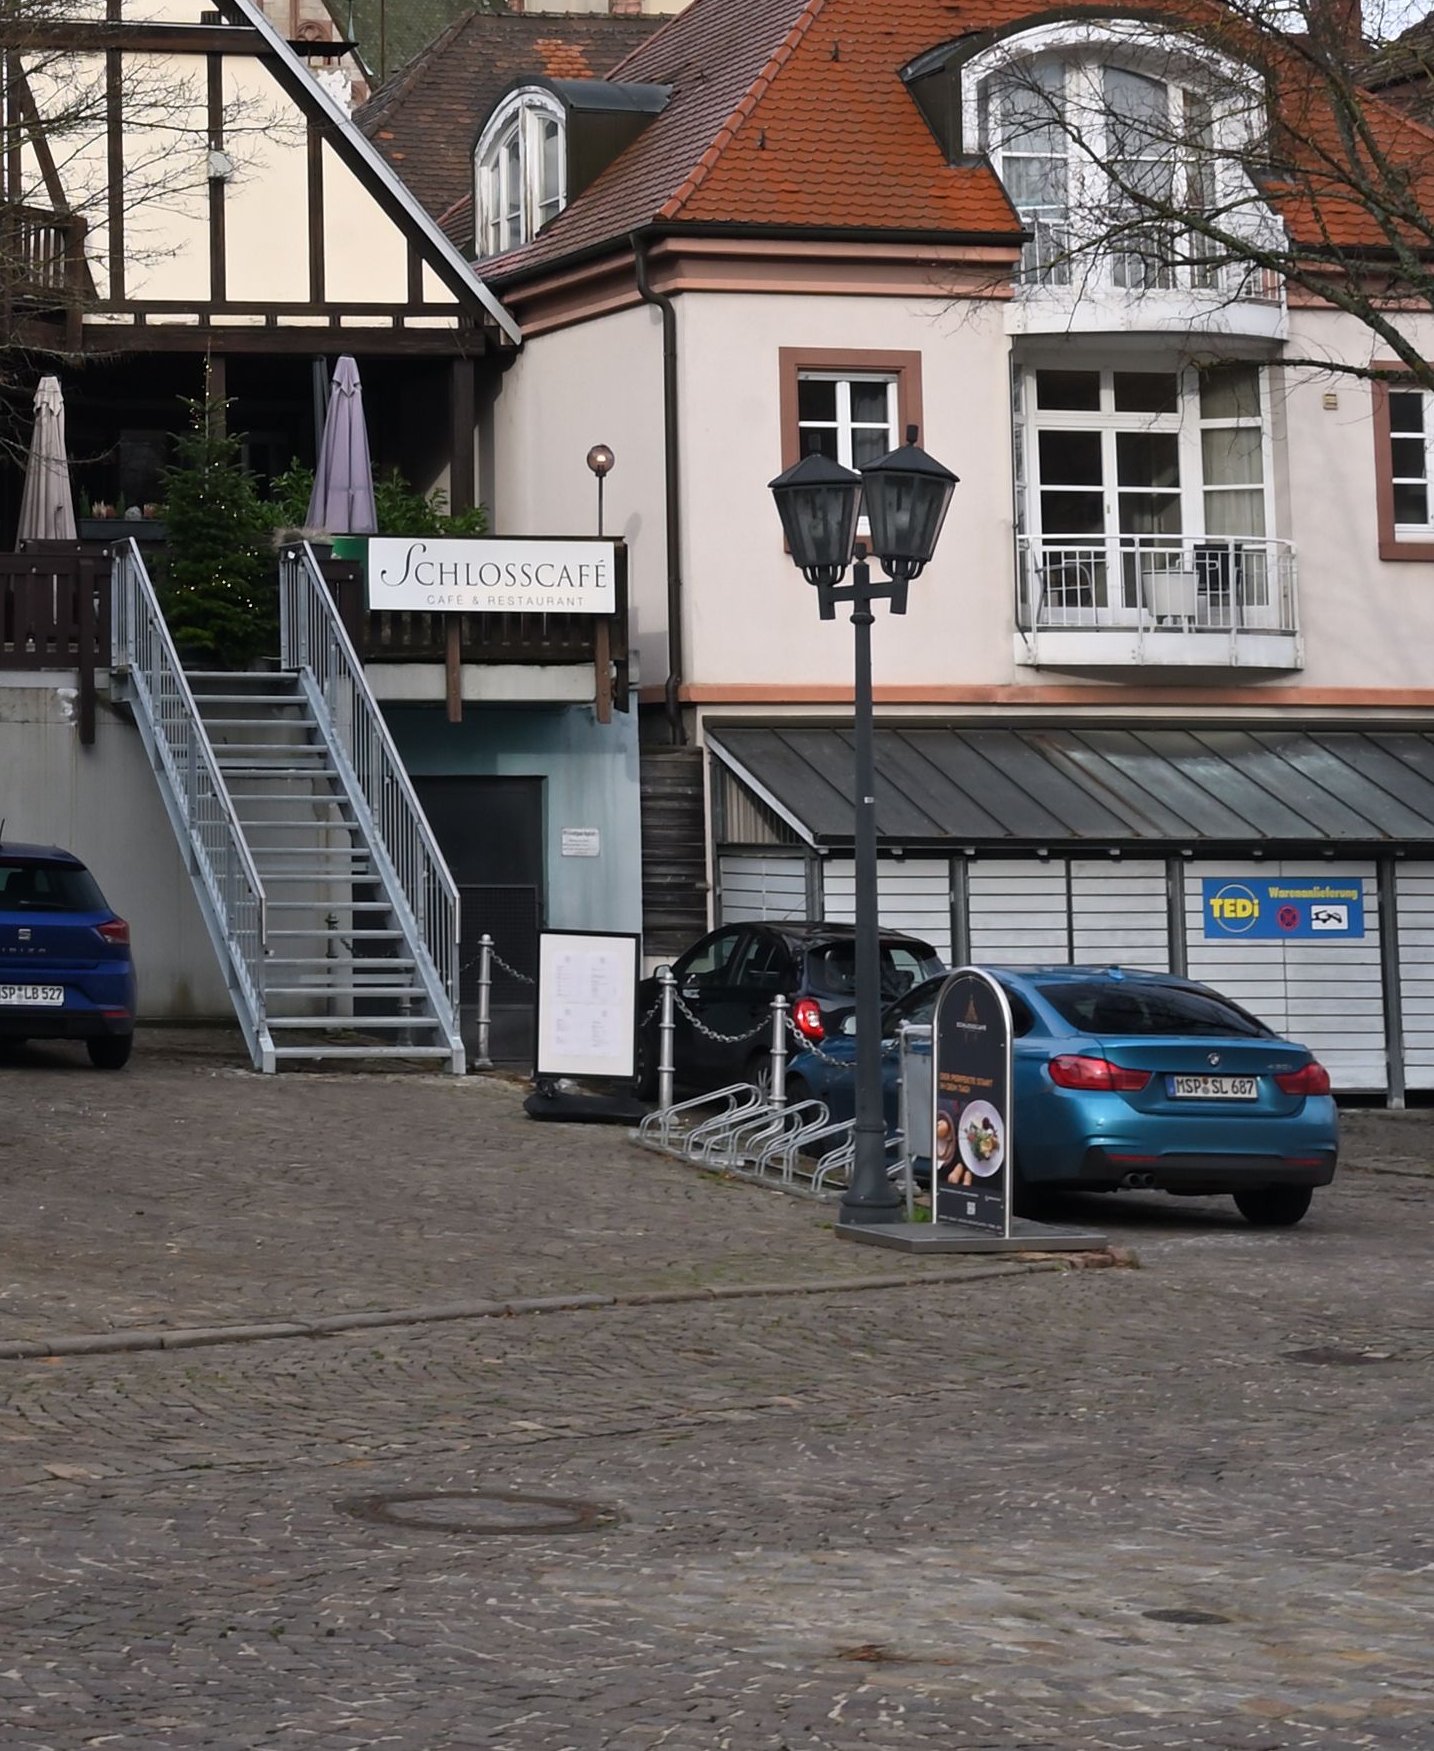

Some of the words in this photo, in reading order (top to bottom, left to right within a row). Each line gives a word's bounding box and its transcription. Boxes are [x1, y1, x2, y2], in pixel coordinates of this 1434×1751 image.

[380, 542, 607, 589] SCHLOSSCAFÉ
[472, 596, 480, 606] &
[488, 596, 584, 607] RESTAURANT
[1268, 886, 1359, 901] Warenanlieferung
[1210, 898, 1260, 919] TEDi
[24, 987, 39, 1000] LB
[41, 988, 63, 1001] 527
[1176, 1078, 1201, 1094] MSP
[1212, 1080, 1228, 1095] SL
[1232, 1080, 1254, 1095] 687
